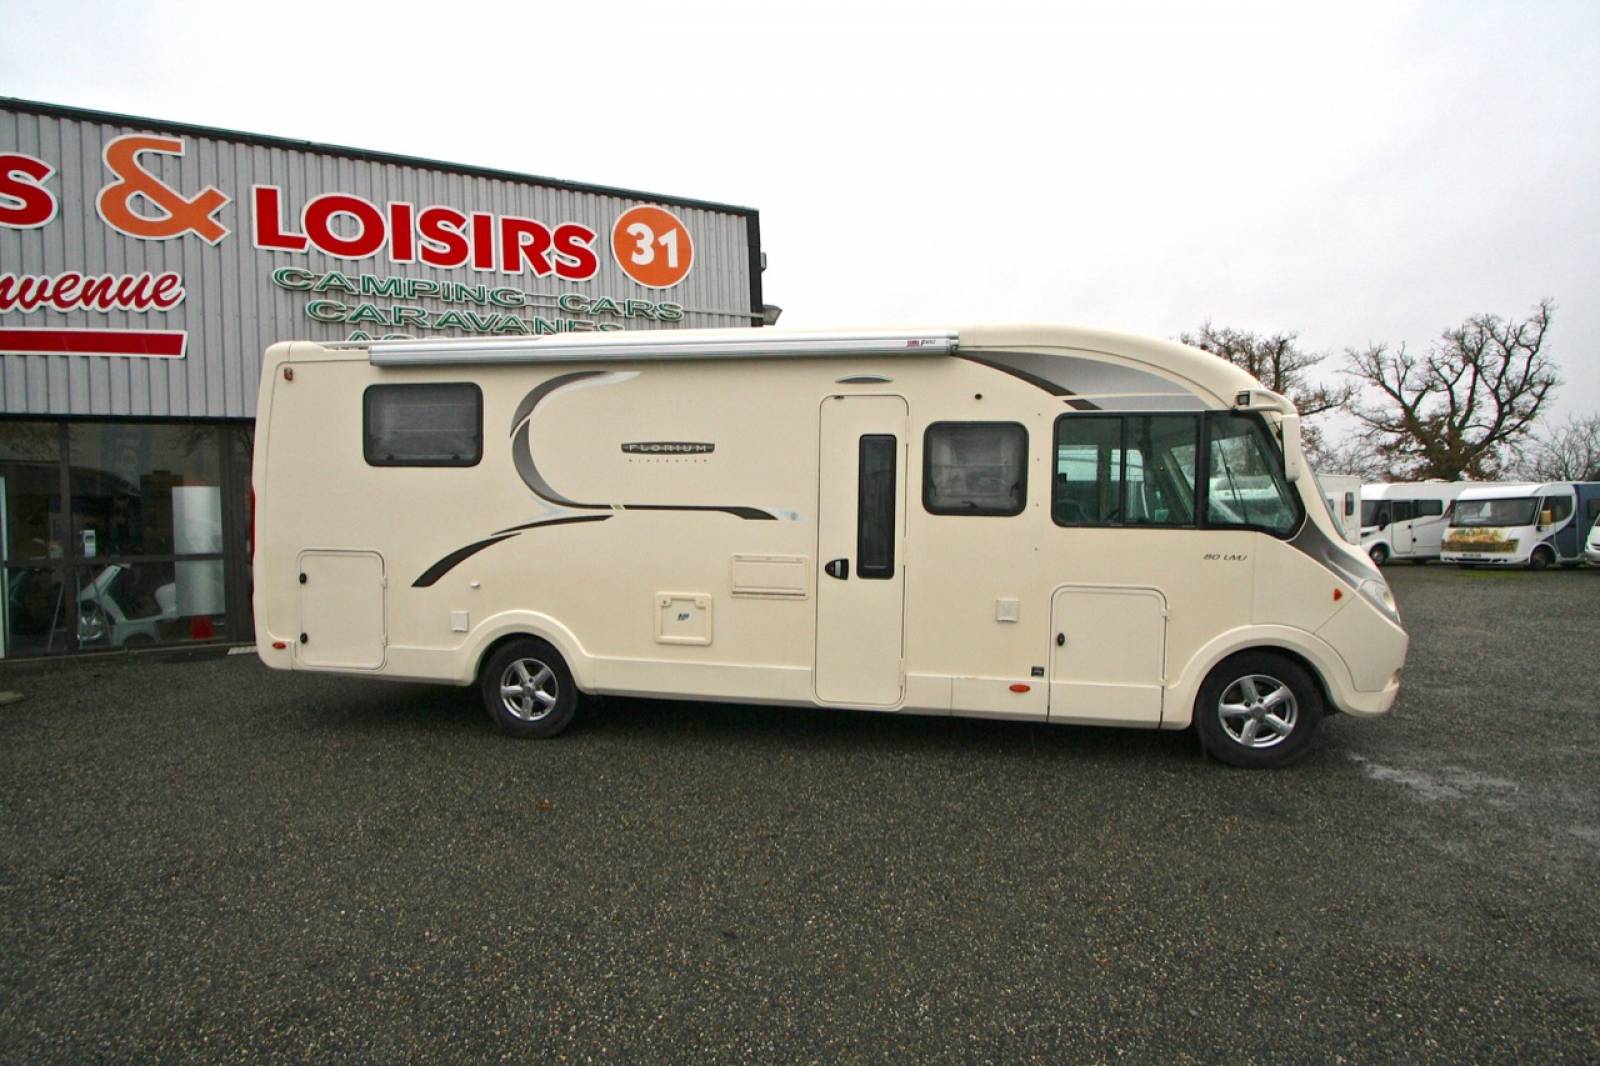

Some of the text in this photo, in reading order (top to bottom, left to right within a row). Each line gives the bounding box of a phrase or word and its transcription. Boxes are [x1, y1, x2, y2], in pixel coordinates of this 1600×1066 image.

[96, 133, 232, 246] &
[252, 184, 600, 282] LOISIRS
[626, 222, 679, 268] 31
[272, 267, 685, 321] CAMPING CARS
